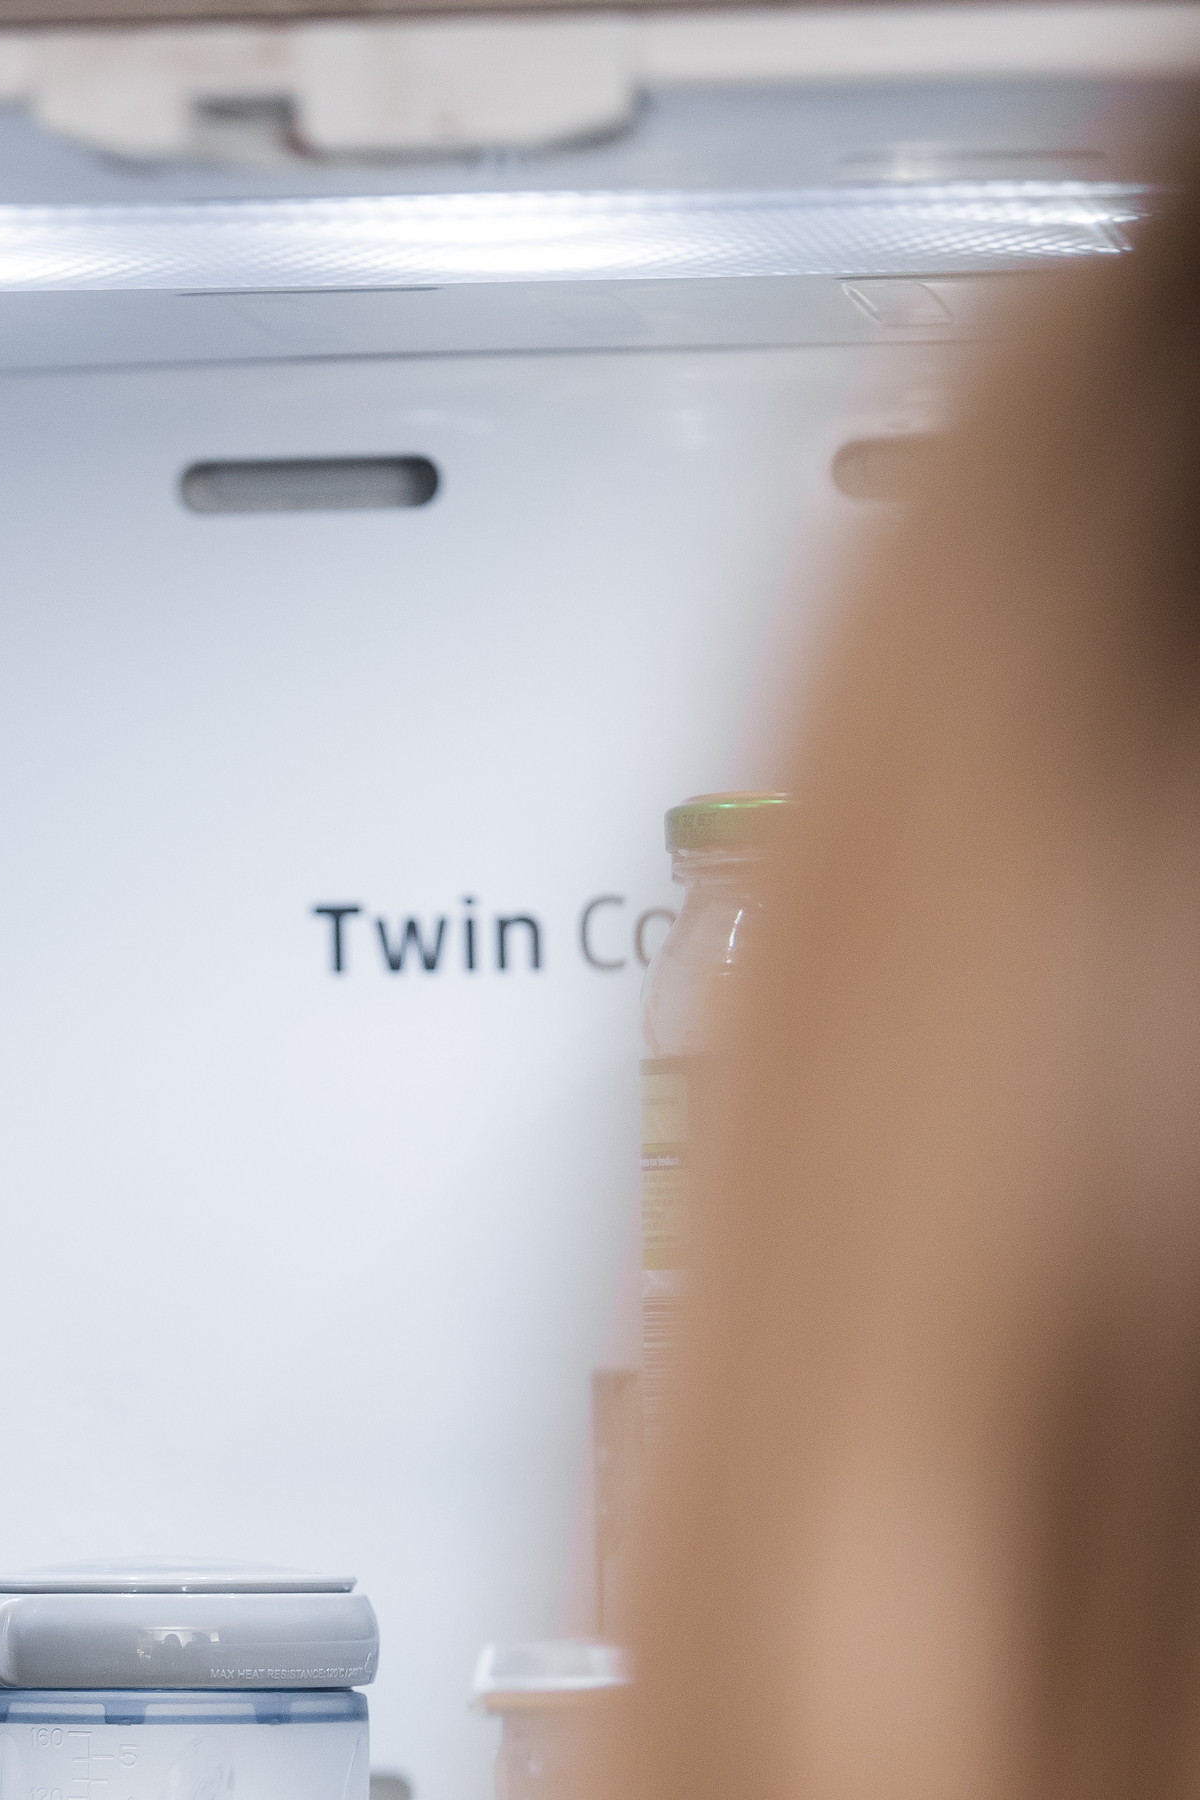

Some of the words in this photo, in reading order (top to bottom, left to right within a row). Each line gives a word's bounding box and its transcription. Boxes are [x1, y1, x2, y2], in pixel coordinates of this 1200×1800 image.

[313, 894, 545, 975] Twin
[210, 1668, 234, 1680] MAX
[238, 1668, 265, 1679] HEAT
[30, 1727, 64, 1749] 160
[119, 1743, 138, 1769] 5
